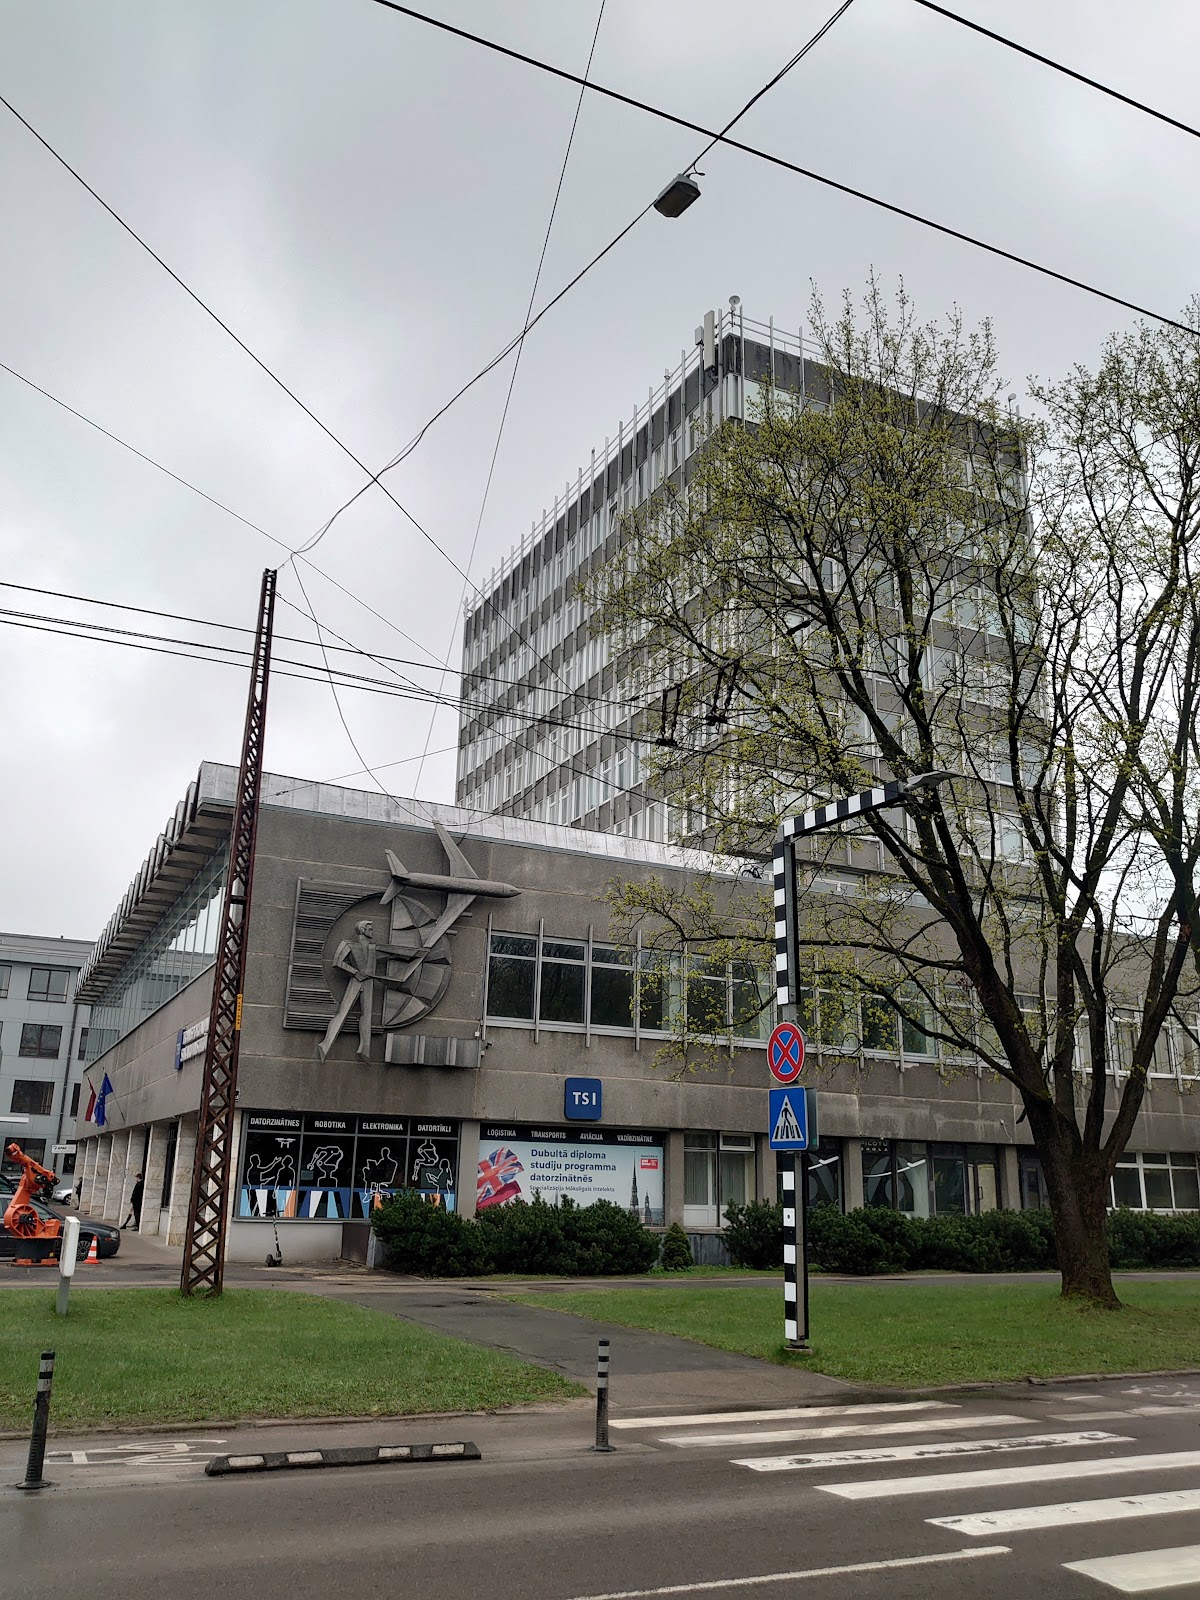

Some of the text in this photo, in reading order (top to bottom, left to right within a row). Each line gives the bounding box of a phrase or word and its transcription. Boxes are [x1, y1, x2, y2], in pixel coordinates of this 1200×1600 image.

[572, 1091, 597, 1106] TSI
[250, 1118, 300, 1127] DATORZINĀTNES
[314, 1120, 346, 1129] ROBOTIKA
[362, 1122, 404, 1131] ELEKTRONIKA
[417, 1124, 452, 1133] DATORTĪKLI
[487, 1128, 517, 1138] LOĢISTIKA
[531, 1130, 567, 1139] TRANSPORTS
[579, 1132, 604, 1141] AVIĀCIJA
[531, 1149, 606, 1160] Dubultā diploma
[530, 1161, 616, 1172] studiju programma
[530, 1173, 593, 1183] datorzinātnēs
